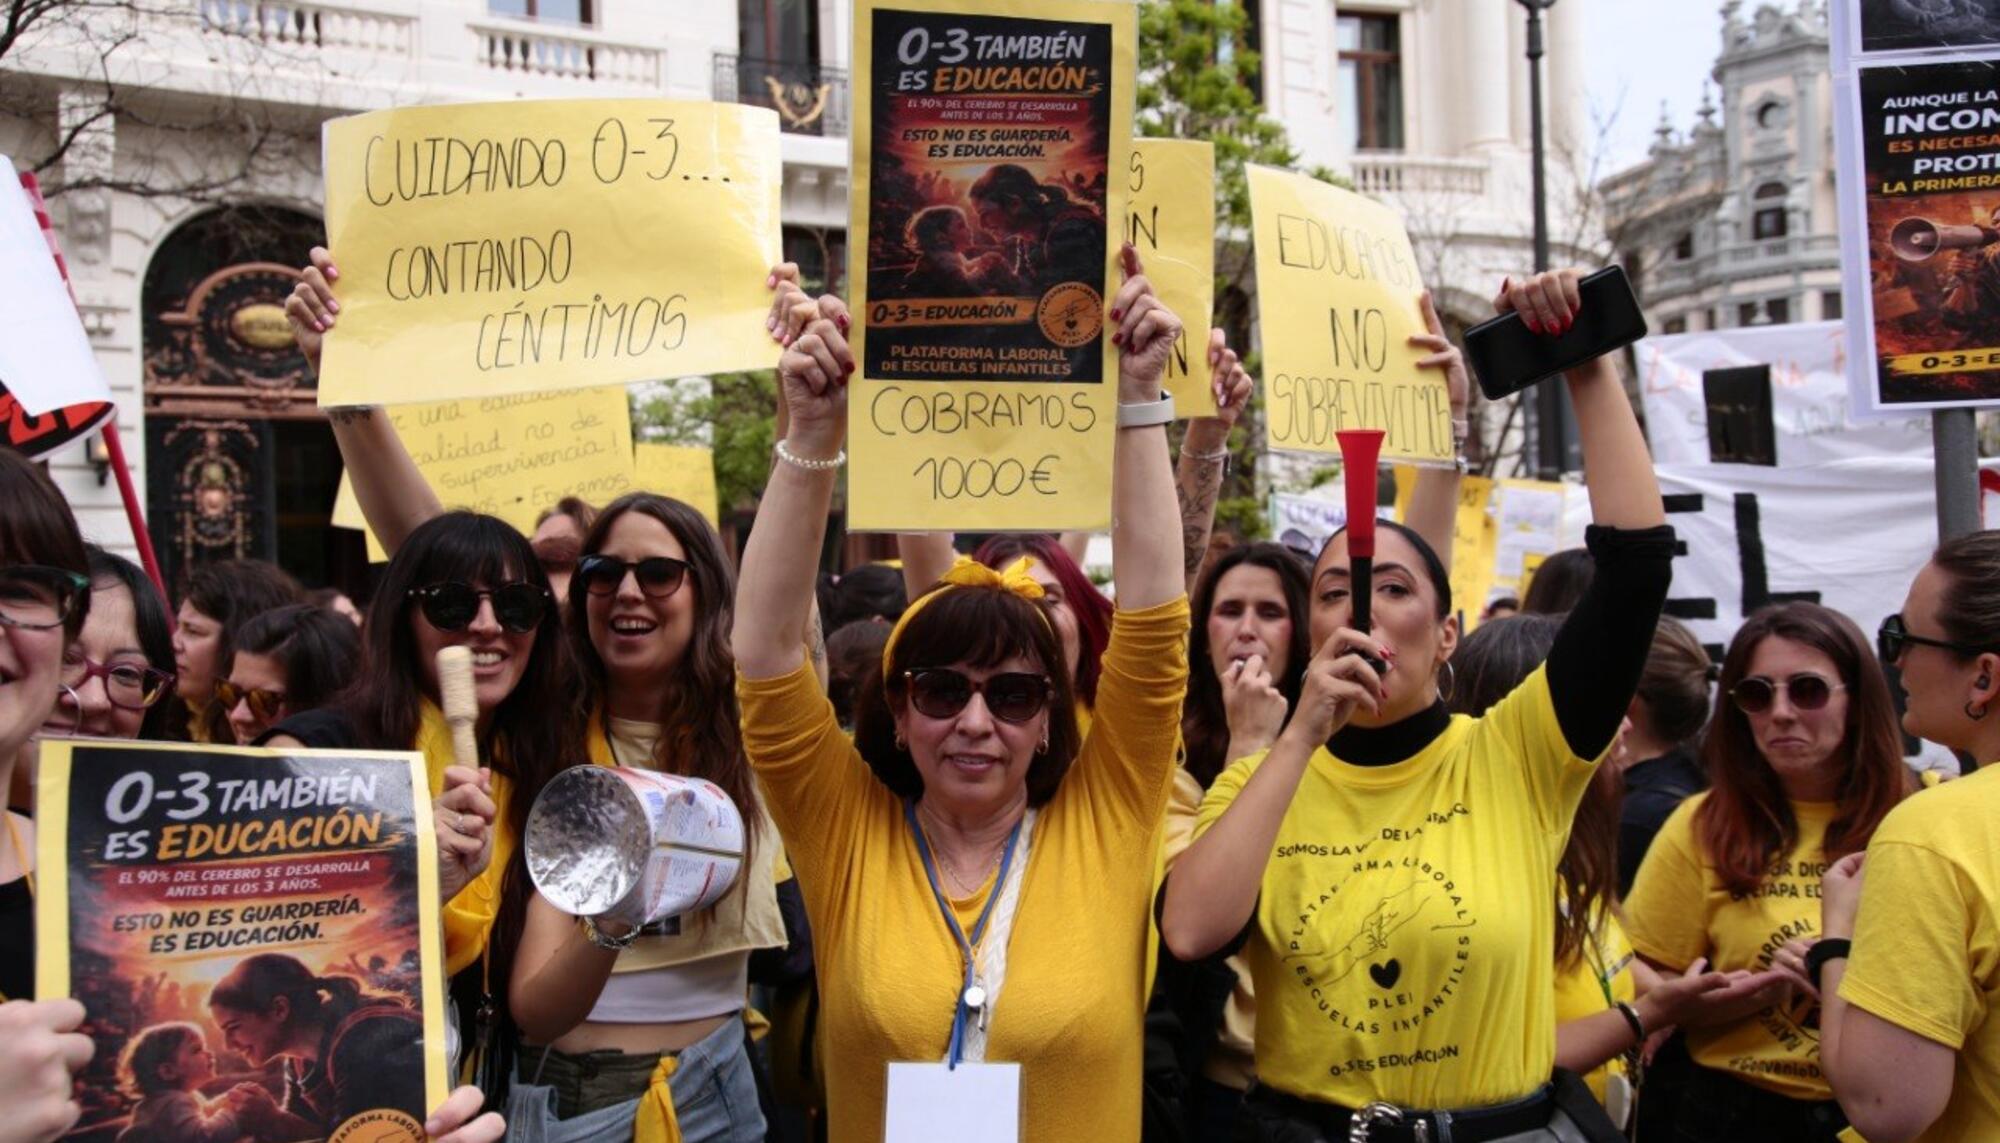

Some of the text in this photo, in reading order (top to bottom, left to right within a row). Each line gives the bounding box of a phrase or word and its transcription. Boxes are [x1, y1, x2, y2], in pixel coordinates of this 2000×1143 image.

[897, 27, 1087, 65] 0-3 TAMBIÉN
[897, 60, 1088, 93] ES EDUCACIÓN
[907, 98, 1078, 111] EL 90% DEL CEREBRO SE DESARROLLA
[1882, 90, 1998, 110] AUNQUE LA
[940, 110, 1045, 121] ANTES DE LOS 3 AÑOS.
[902, 126, 1074, 143] ESTO NO ES GUARDERÍA.
[1888, 139, 1914, 153] ES
[928, 142, 1046, 158] ES EDUCACIÓN.
[365, 135, 566, 207] CUIDANDO
[1882, 182, 1907, 194] LA
[387, 229, 572, 301] CONTANDO
[891, 345, 1068, 361] PLATAFORMA LABORAL
[1330, 307, 1387, 372] NO
[881, 360, 1072, 376] DE ESCUELAS INFANTILES
[1921, 355, 1967, 369] 0-3
[871, 386, 1096, 436] COBRAMOS
[525, 421, 555, 442] no
[913, 454, 1061, 500] 1000€
[105, 769, 377, 824] 0-3 TAMBIÉN
[104, 806, 382, 860] ES EDUCACIÓN
[1277, 842, 1328, 858] SOMOS
[1332, 846, 1351, 856] LA
[1382, 828, 1401, 841] DE
[118, 859, 370, 884] EL 90% DEL CEREBRO SE DESARROLLA
[165, 876, 321, 898] ANTES DE LOS 3 AÑOS.
[112, 894, 367, 933] ESTO NO ES GUARDERÍA.
[1290, 859, 1394, 951] PLATAFRMA
[149, 921, 324, 954] ES EDUCACIÓN.
[1296, 936, 1470, 1034] ESCUELAS INFANTILES
